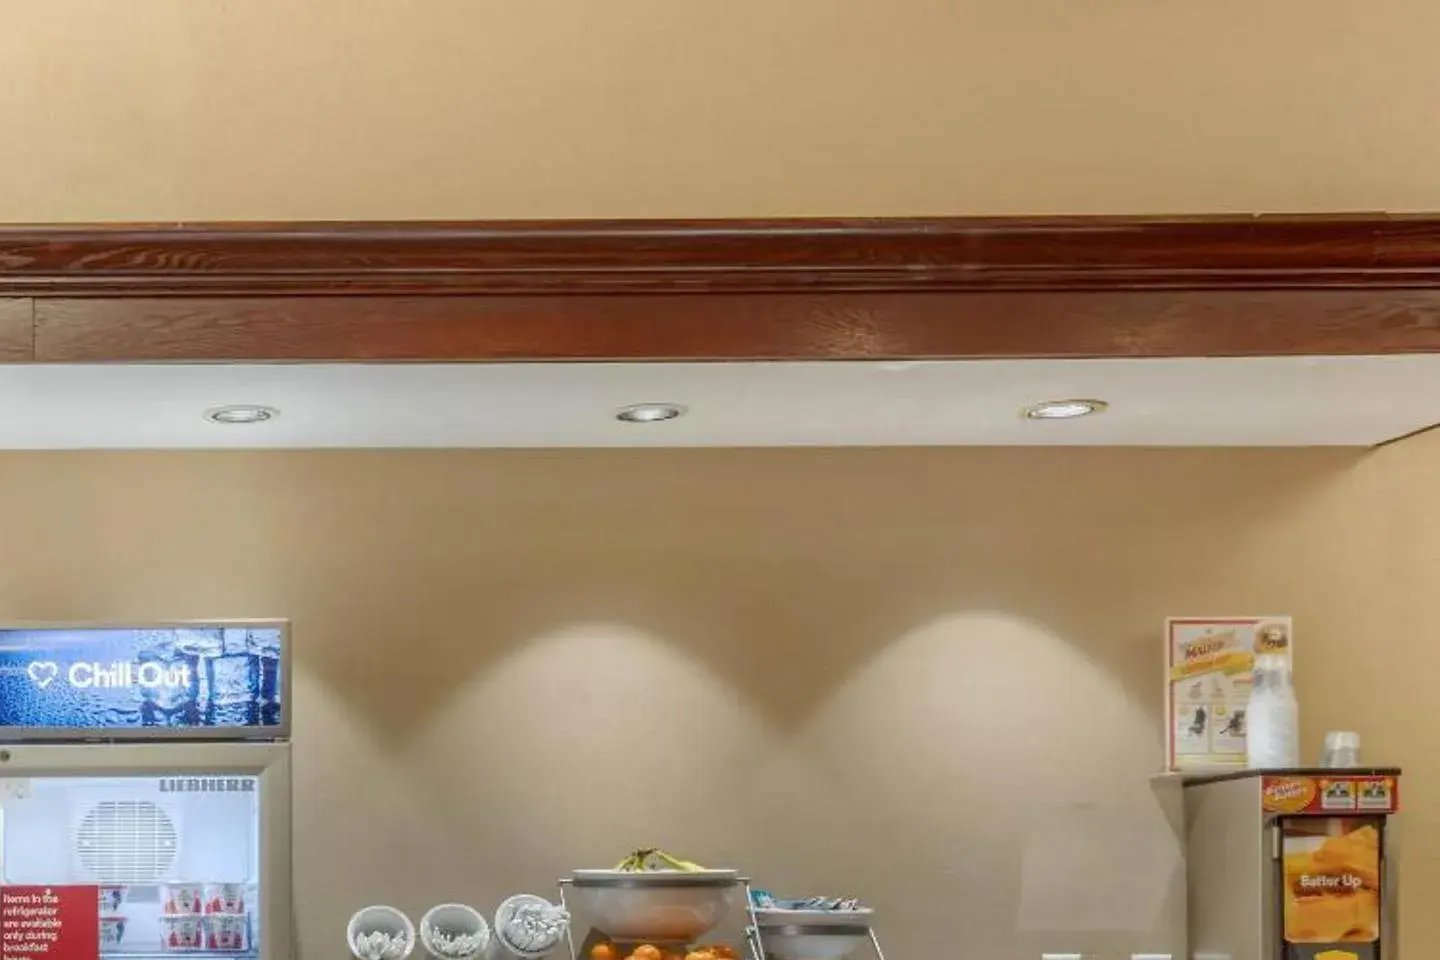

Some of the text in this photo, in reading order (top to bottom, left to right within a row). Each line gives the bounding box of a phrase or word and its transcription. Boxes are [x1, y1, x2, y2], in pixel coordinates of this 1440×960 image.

[68, 661, 191, 688] Chill Out
[159, 778, 256, 792] LIEBHERR
[1300, 873, 1362, 888] Batter Up
[3, 893, 59, 903] Items in the
[3, 906, 58, 918] refrigerator
[3, 918, 62, 928] are available
[3, 931, 58, 942] only during
[3, 943, 49, 952] breakfast
